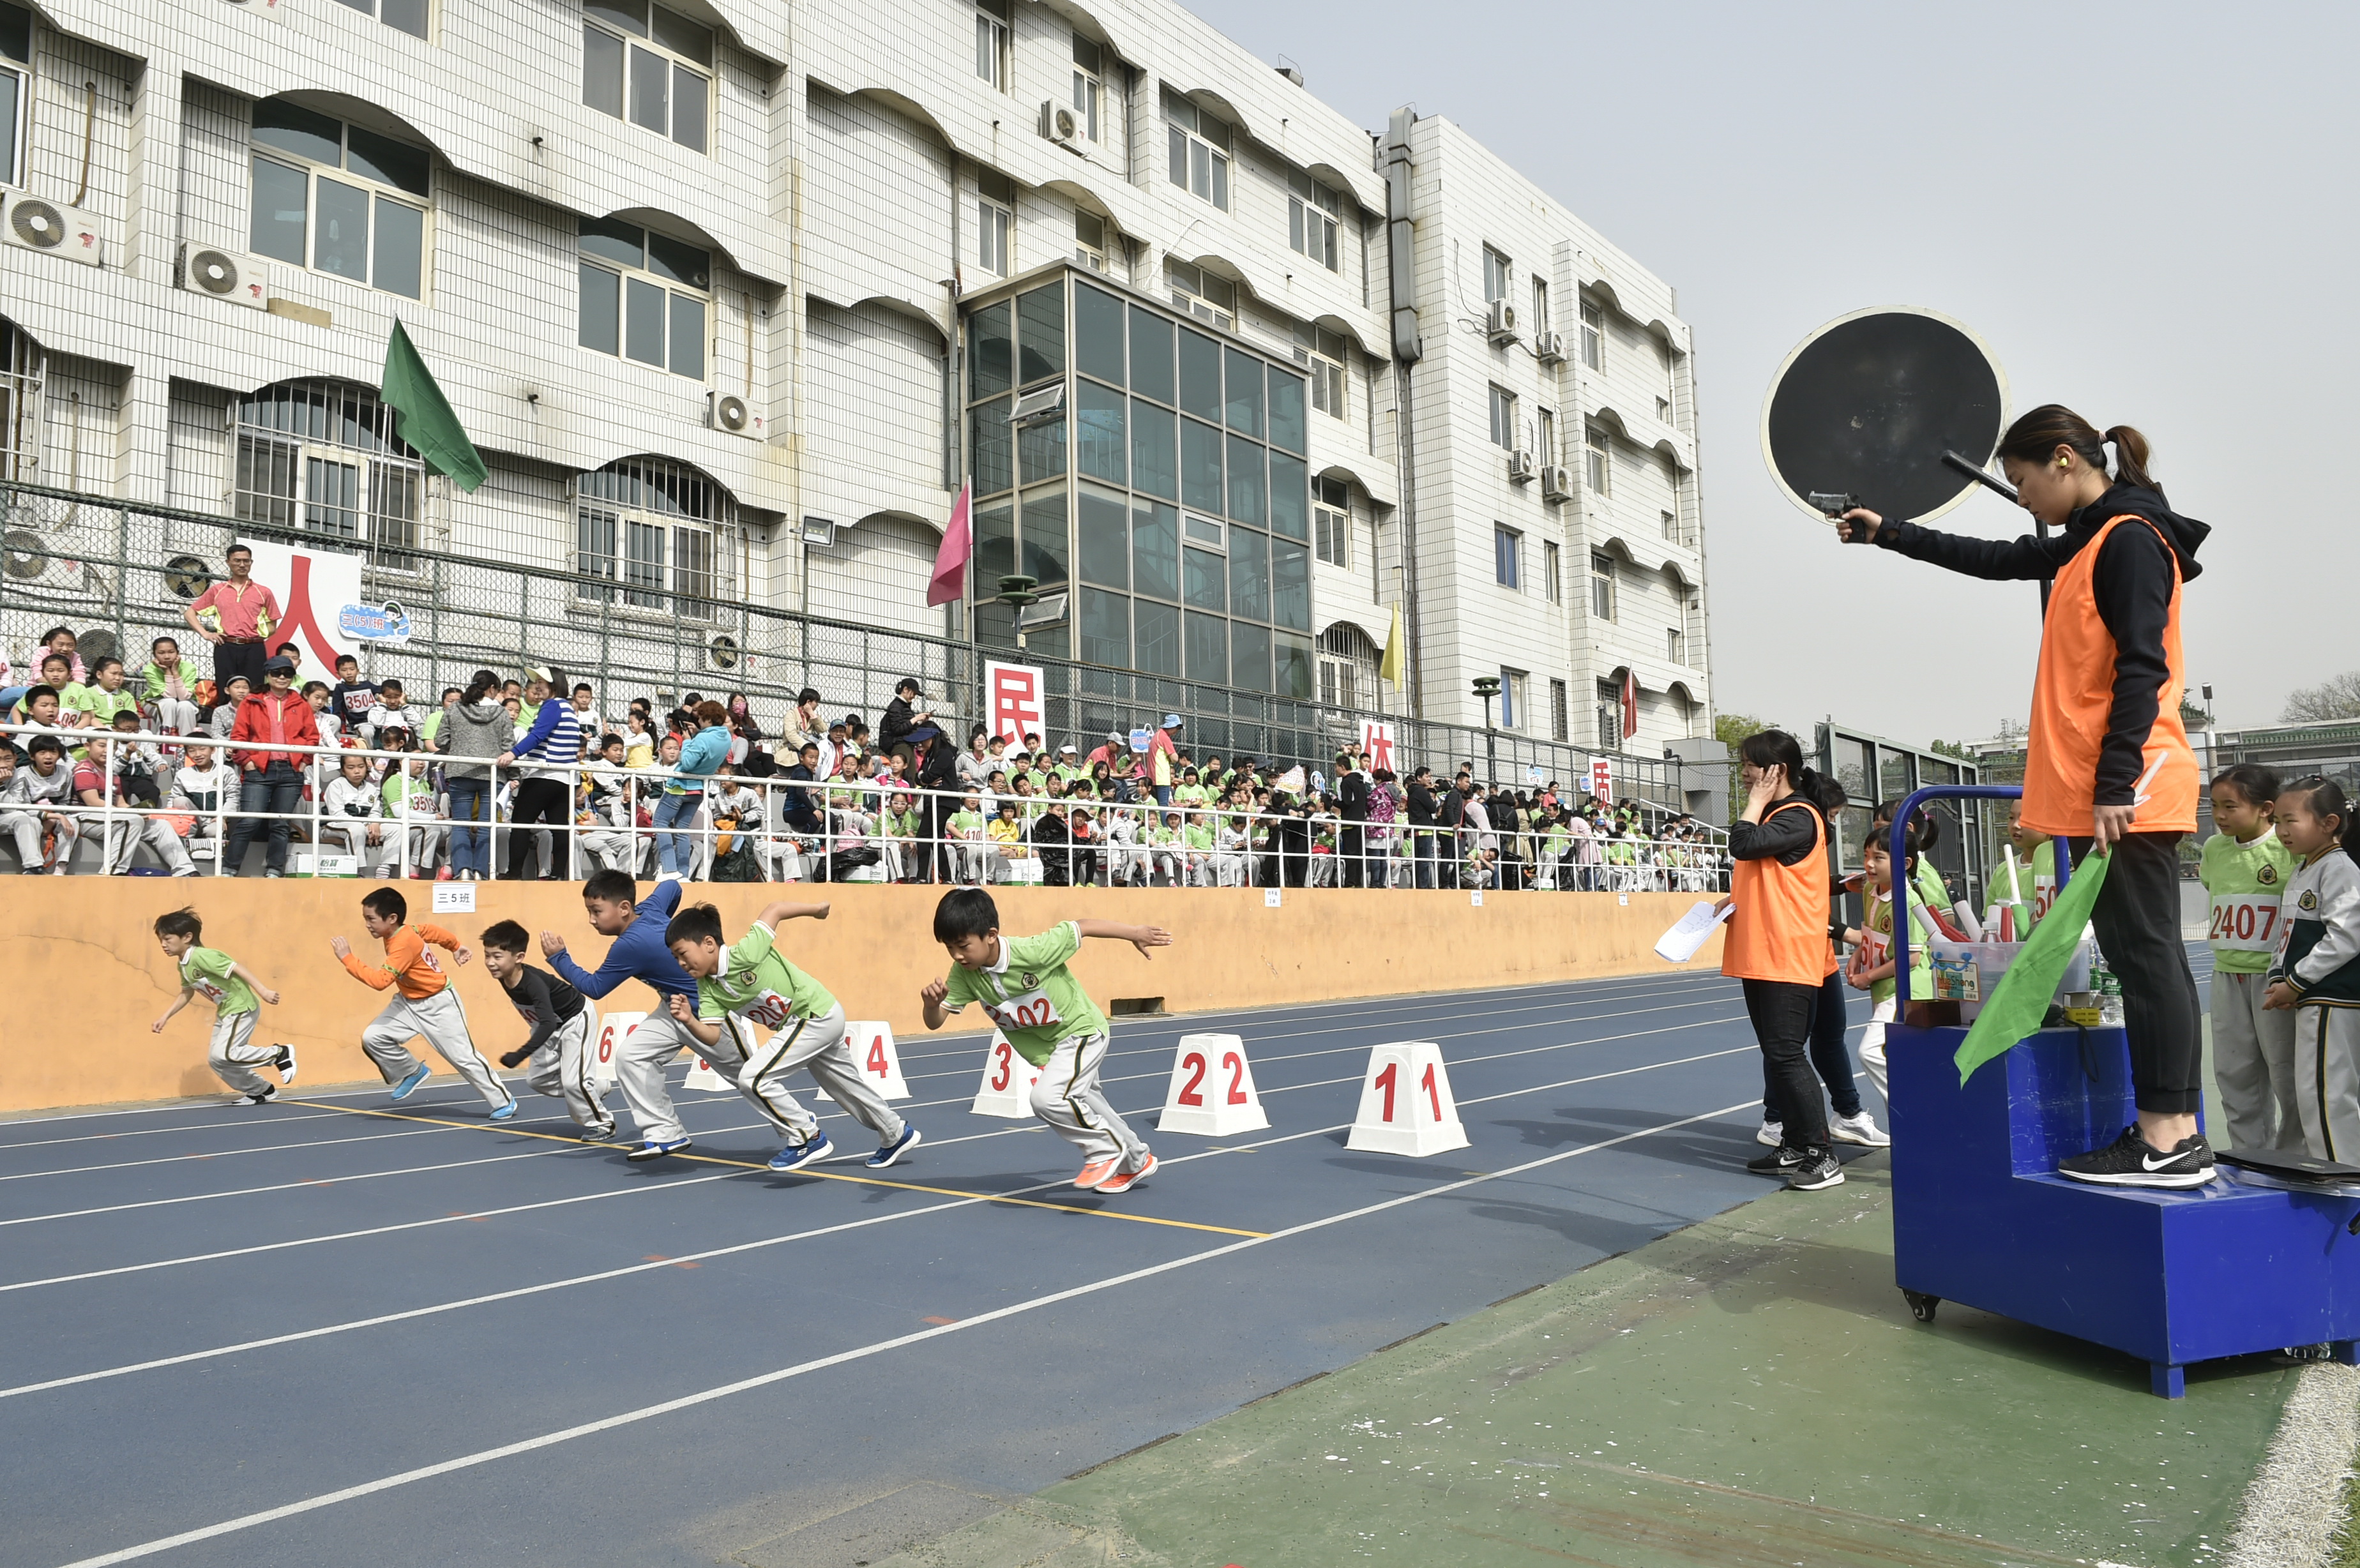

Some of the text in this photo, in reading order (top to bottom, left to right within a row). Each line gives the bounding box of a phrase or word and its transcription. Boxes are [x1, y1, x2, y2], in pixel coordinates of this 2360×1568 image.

[264, 555, 342, 681] 人
[342, 614, 385, 629] 三(5)班
[345, 693, 377, 710] 3504
[994, 668, 1041, 751] 民
[412, 795, 438, 811] 3513
[2210, 904, 2277, 940] 2407
[986, 998, 1059, 1029] 2102
[599, 1026, 614, 1063] 6
[866, 1035, 888, 1078] 4
[992, 1043, 1011, 1091] 3
[1177, 1052, 1206, 1106] 2
[1223, 1052, 1247, 1105] 2
[1375, 1063, 1396, 1122] 1
[1421, 1063, 1441, 1122] 1
